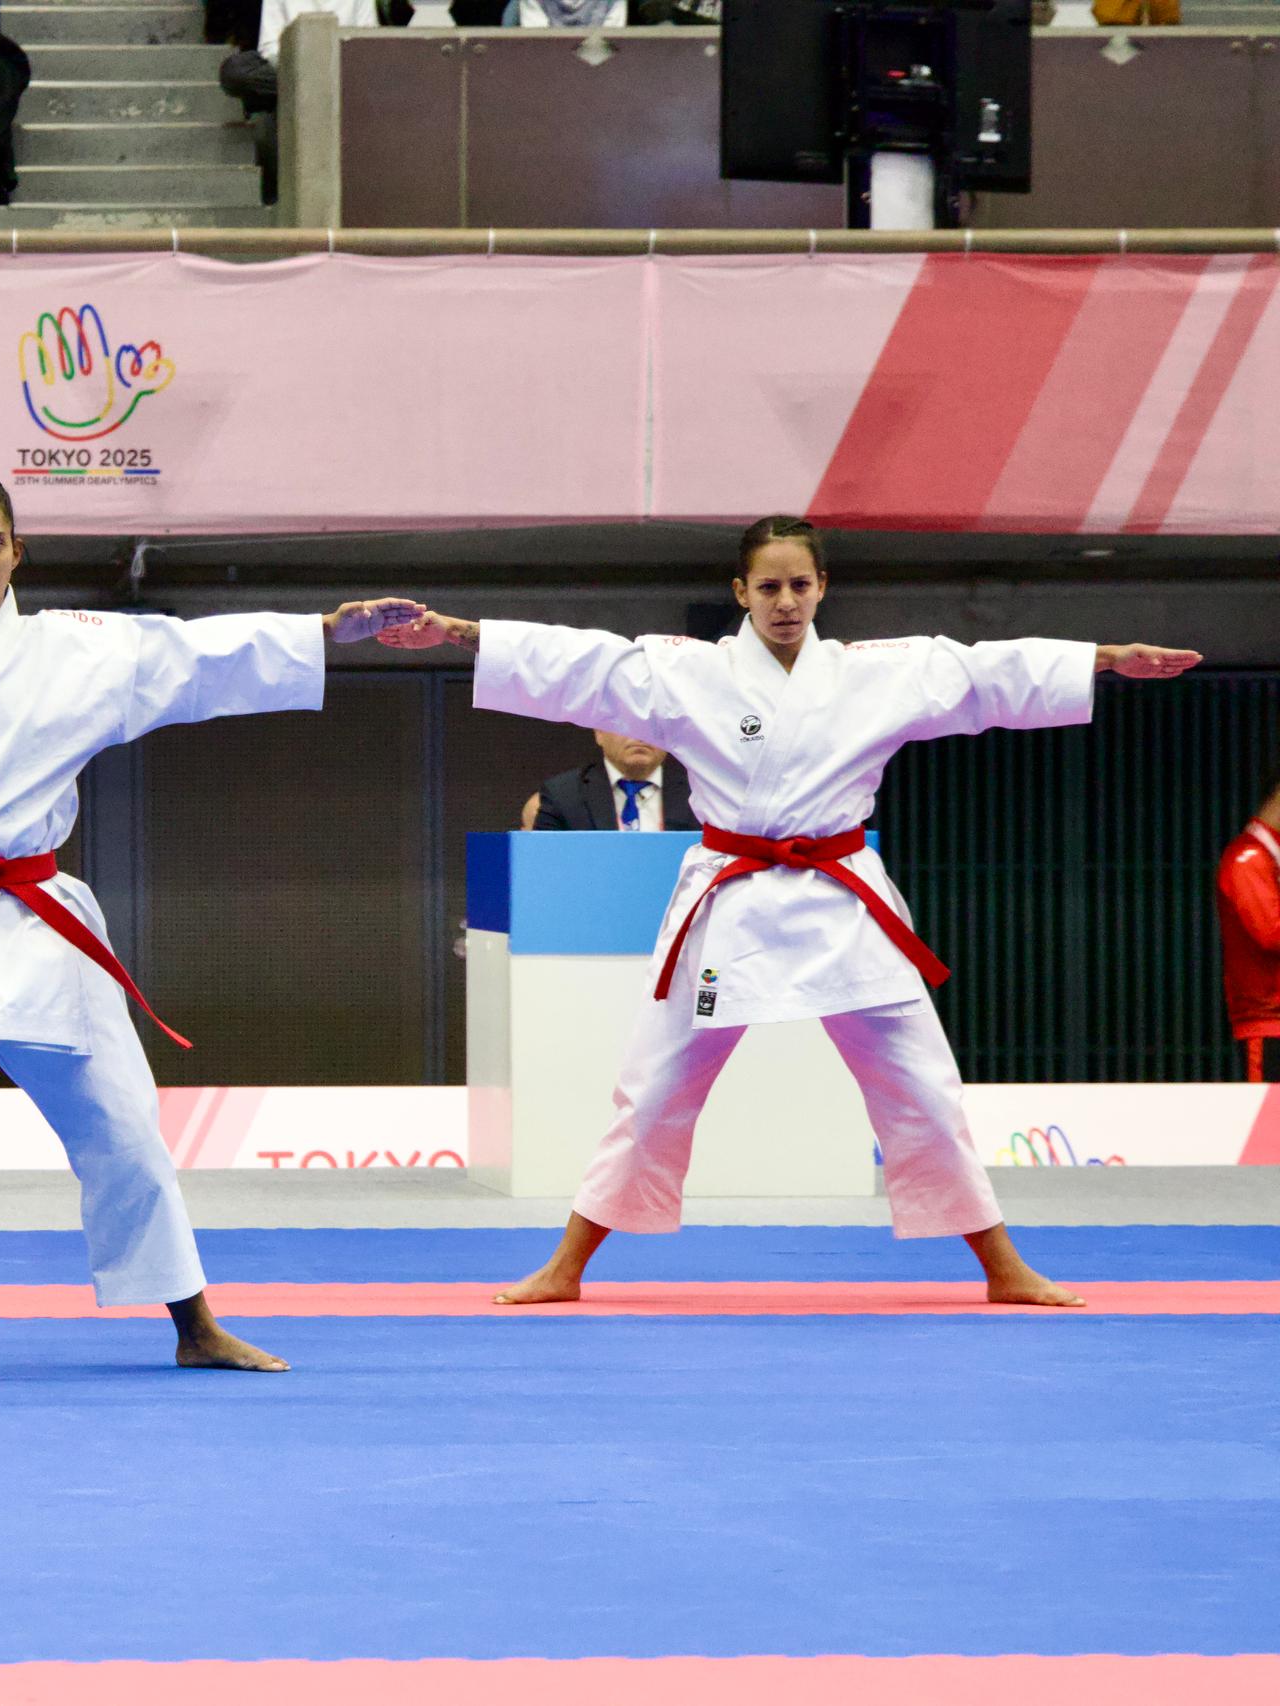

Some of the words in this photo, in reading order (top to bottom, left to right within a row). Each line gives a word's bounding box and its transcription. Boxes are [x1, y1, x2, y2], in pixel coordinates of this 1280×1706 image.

[17, 449, 91, 467] TOKYO
[100, 449, 152, 467] 2025
[14, 476, 39, 485] 25TH
[42, 476, 85, 485] SUMMER
[87, 476, 157, 485] DEAFLYMPICS
